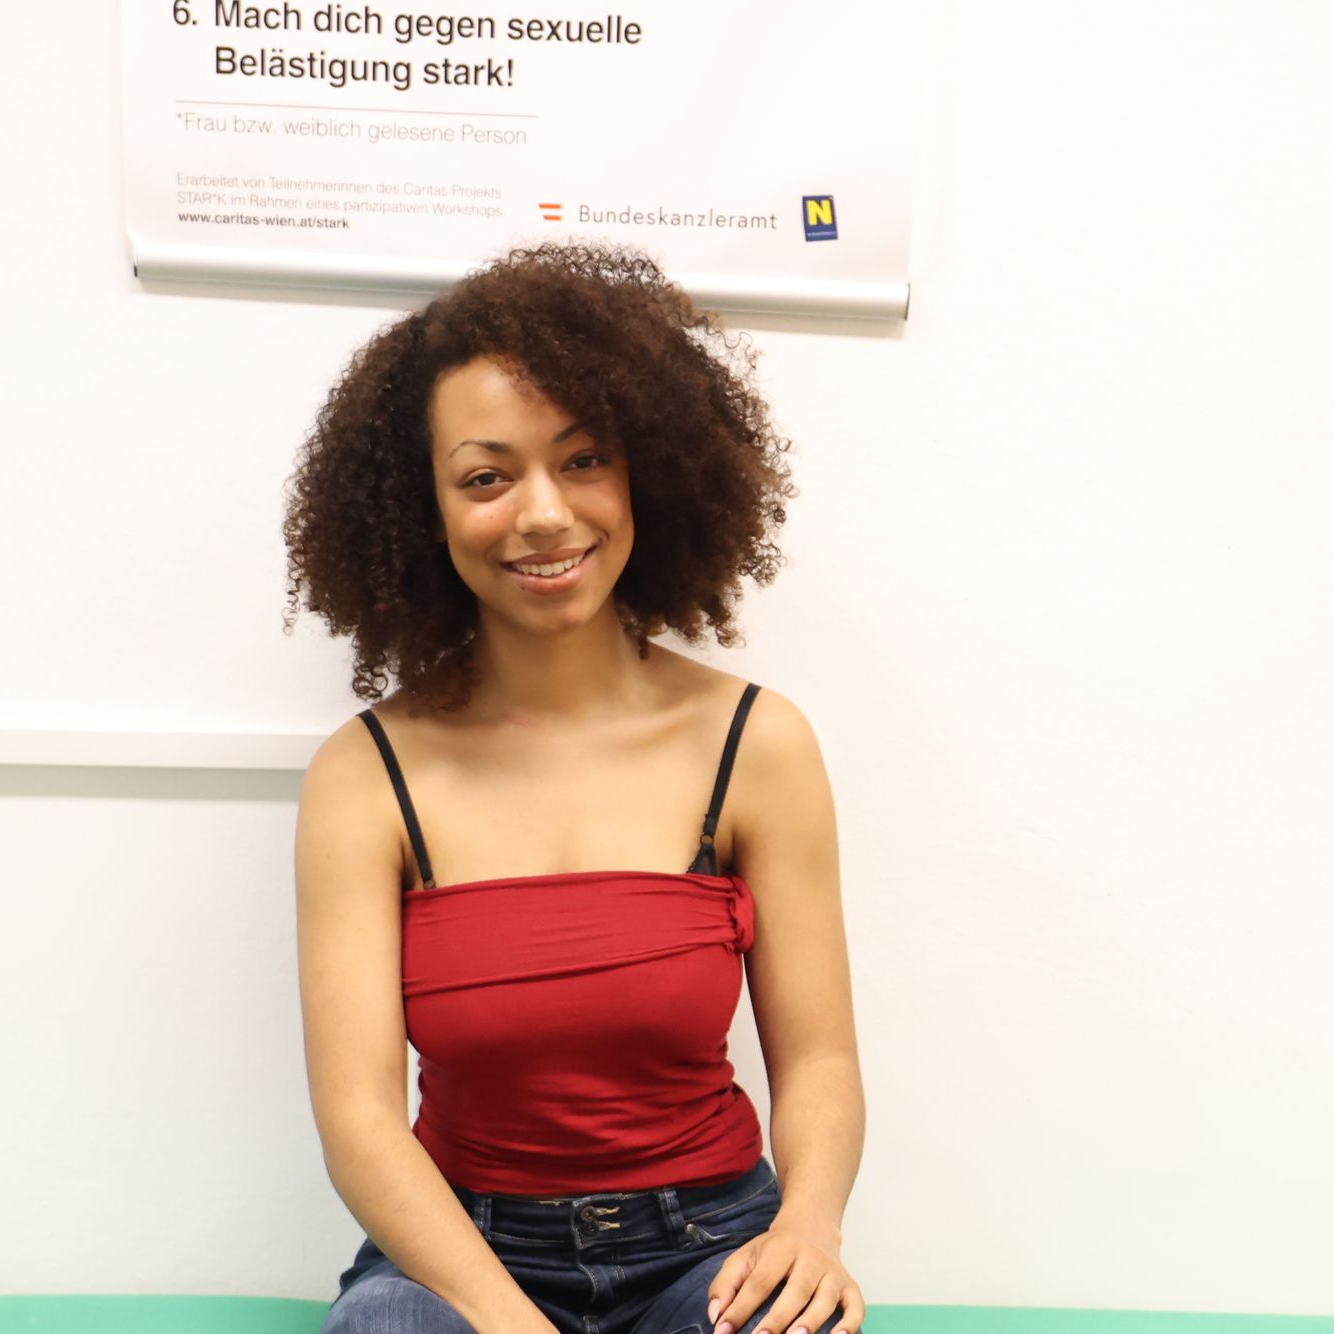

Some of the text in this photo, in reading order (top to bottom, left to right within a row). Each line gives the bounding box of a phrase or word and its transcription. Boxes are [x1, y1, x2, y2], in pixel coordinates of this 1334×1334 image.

[172, 0, 643, 45] 6. Mach dich gegen sexuelle
[215, 47, 515, 91] Belästigung stark!
[233, 114, 276, 135] bzw.
[283, 117, 361, 139] weiblich
[368, 122, 455, 144] gelesene
[462, 124, 528, 145] Person
[176, 172, 239, 189] Erarbeitet
[242, 178, 266, 190] von
[376, 180, 401, 195] des
[403, 182, 449, 197] Caritas
[452, 184, 502, 201] Projekts
[230, 193, 246, 206] im
[249, 193, 303, 209] Rahmen
[306, 197, 341, 211] eines
[343, 197, 429, 215] partizipativen
[578, 204, 778, 230] Bundeskanzleramt
[806, 199, 834, 226] N
[177, 209, 351, 231] www.caritas-wien.at/stark
